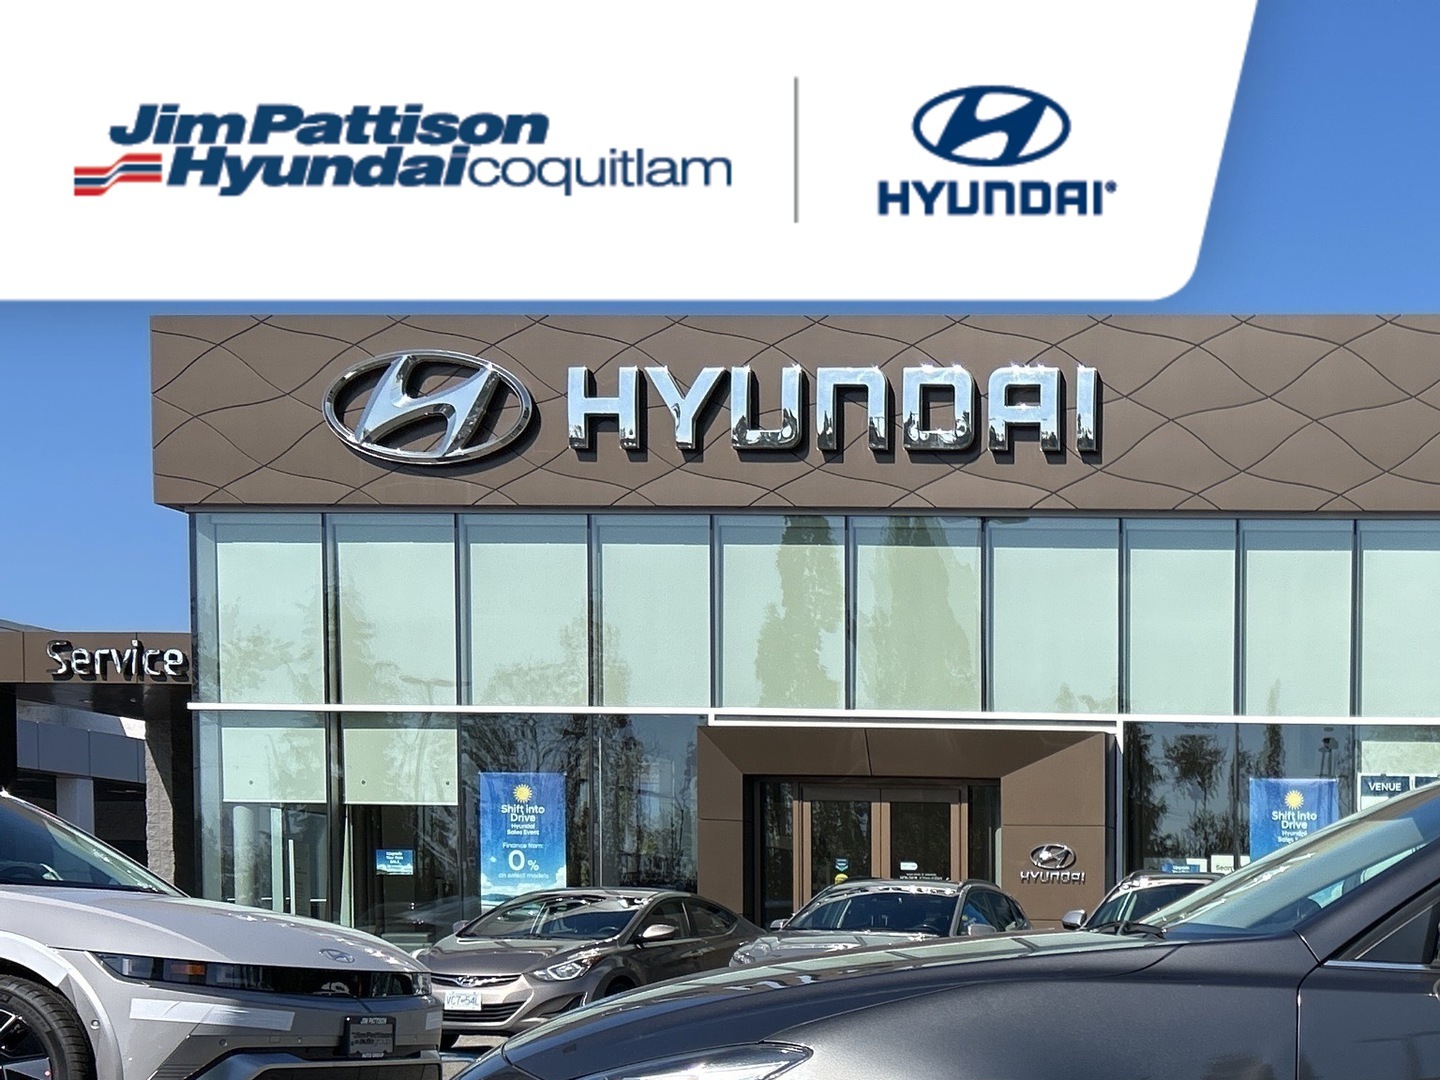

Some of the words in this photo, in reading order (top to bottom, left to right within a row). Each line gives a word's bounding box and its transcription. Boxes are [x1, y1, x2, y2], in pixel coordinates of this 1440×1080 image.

[567, 365, 1100, 452] HYUNDAI
[46, 639, 186, 677] Service
[1368, 782, 1402, 792] VENUE
[501, 804, 524, 814] Shift
[526, 804, 545, 814] into
[510, 814, 536, 822] Drive
[1272, 811, 1295, 821] Shift
[1281, 820, 1308, 829] Drive
[508, 850, 525, 871] 0
[1020, 871, 1086, 885] HYUNDAI
